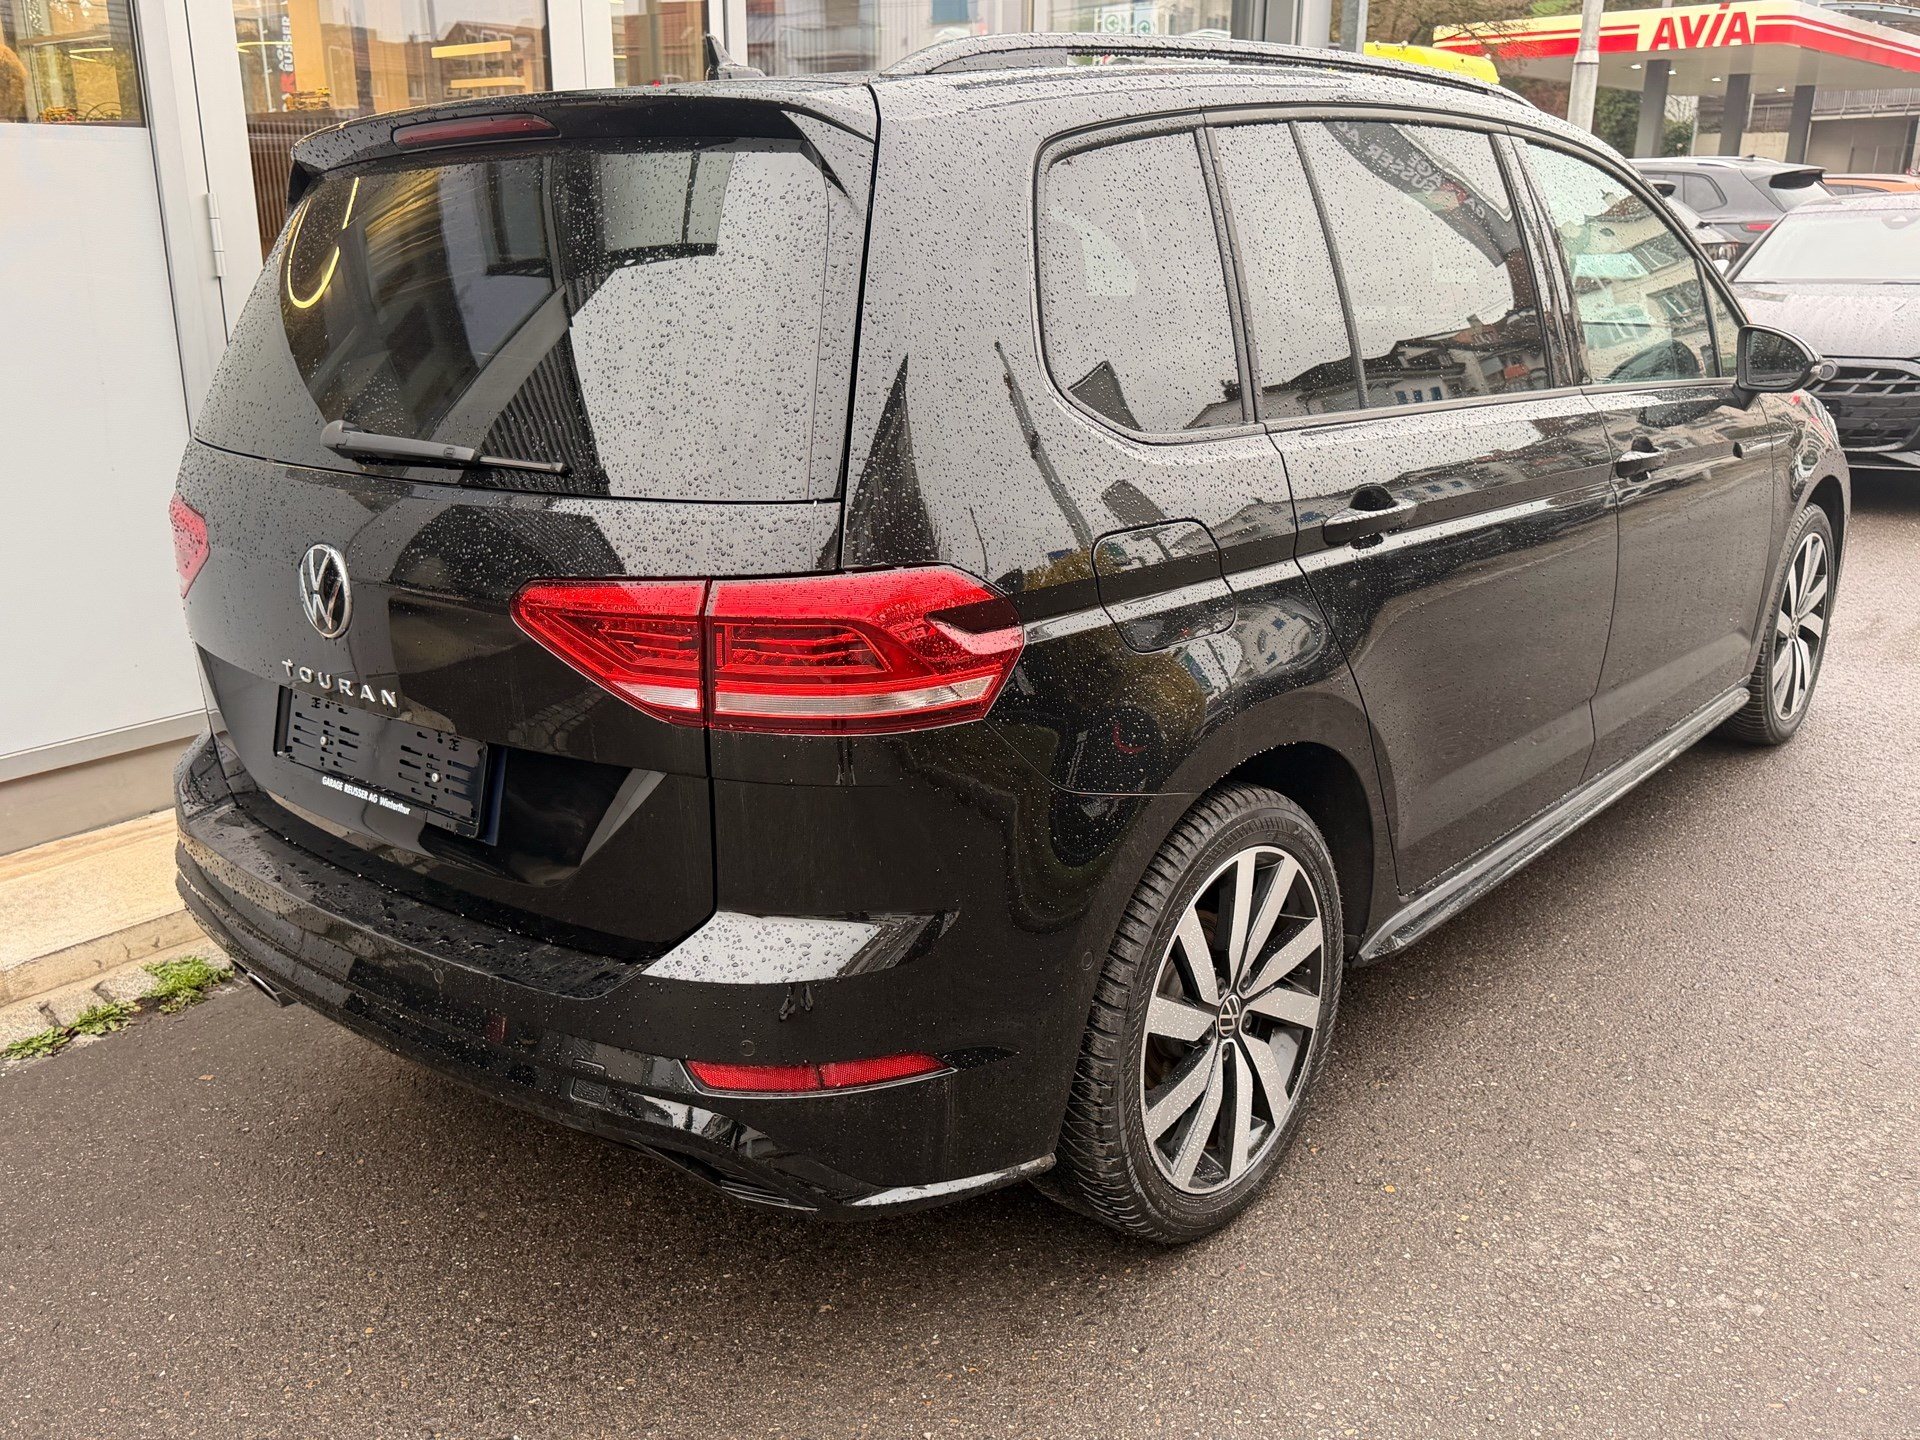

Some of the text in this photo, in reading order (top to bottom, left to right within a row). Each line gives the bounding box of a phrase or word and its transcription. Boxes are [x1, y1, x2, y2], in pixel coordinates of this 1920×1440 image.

[1649, 2, 1751, 51] AVIA
[281, 658, 398, 708] TOURAN
[322, 776, 411, 815] GARAGE REUSSER AG Winterthur
